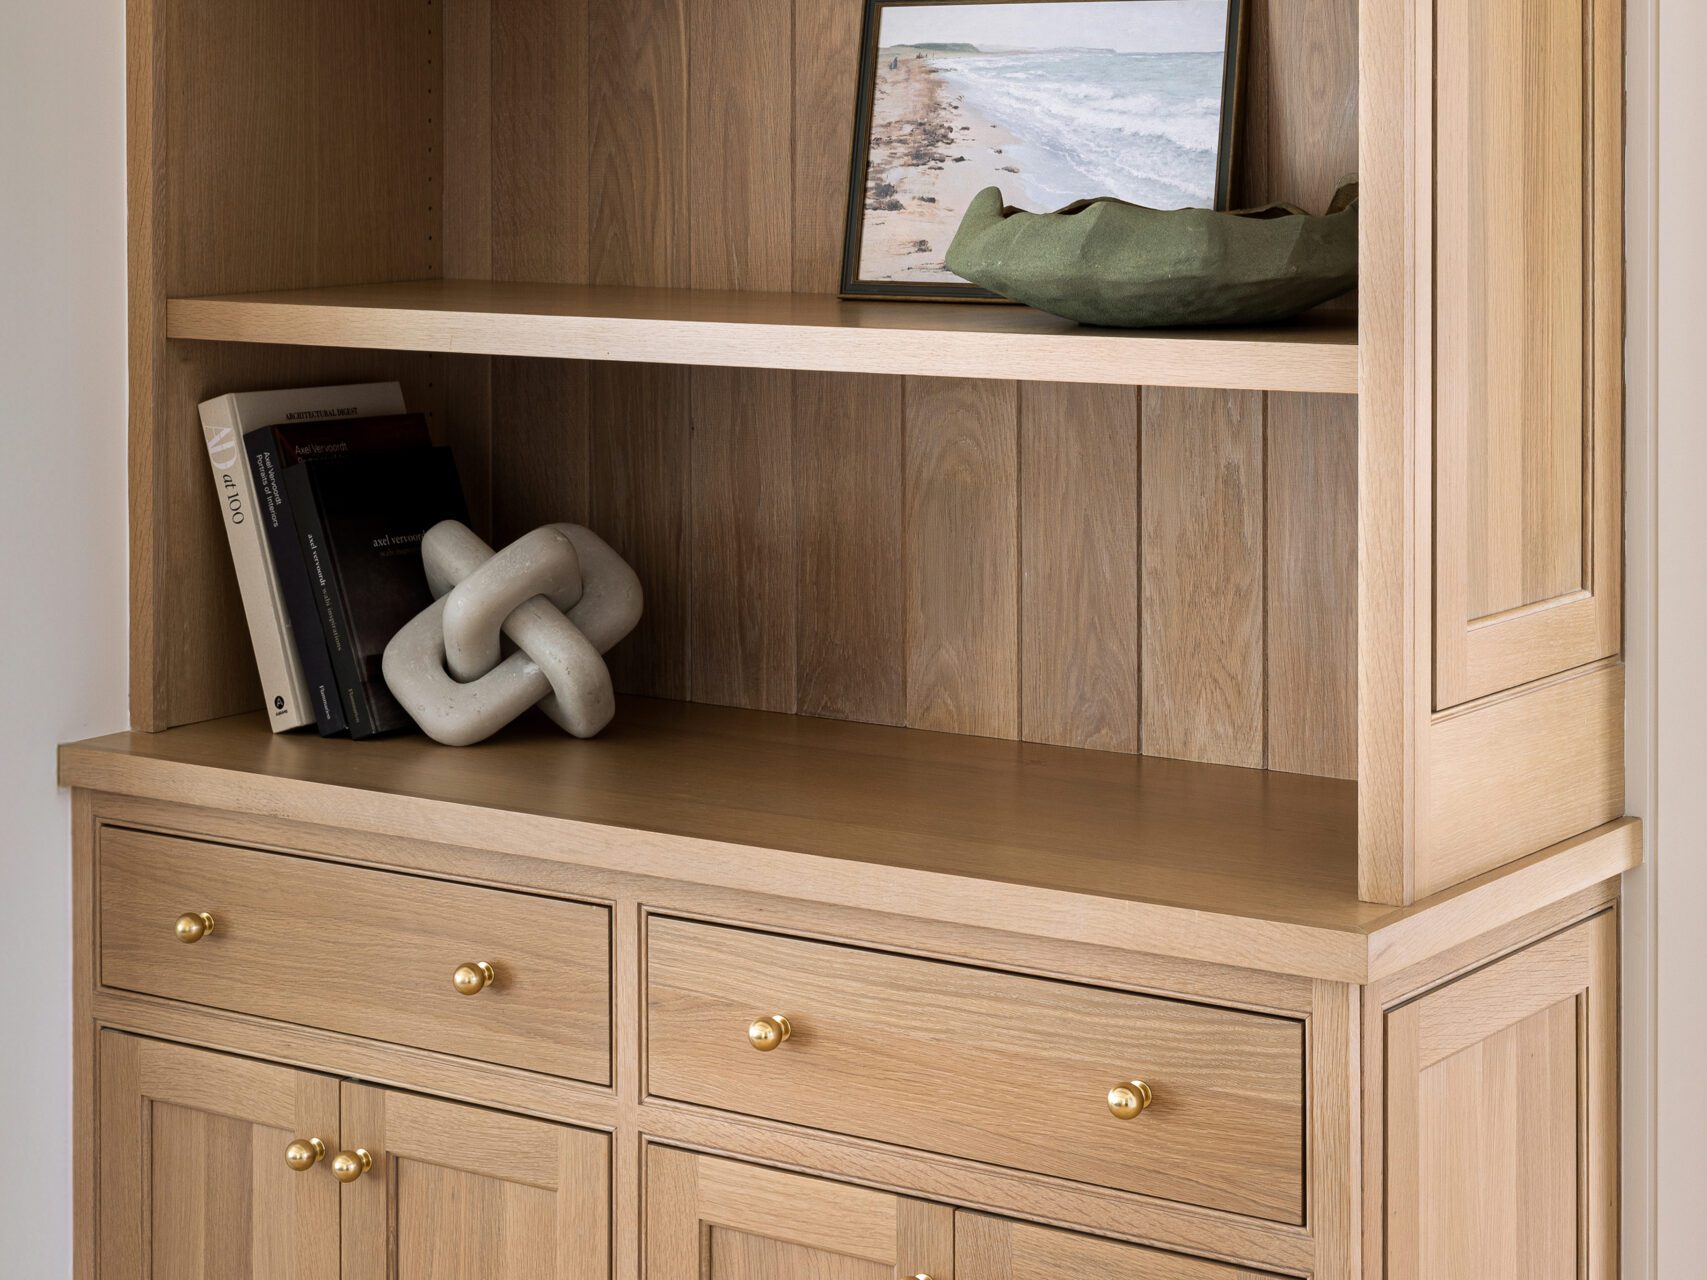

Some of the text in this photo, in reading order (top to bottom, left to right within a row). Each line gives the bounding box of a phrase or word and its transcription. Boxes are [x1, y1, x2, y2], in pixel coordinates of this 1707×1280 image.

[295, 444, 311, 455] Axel
[203, 425, 245, 525] AD at 100
[256, 454, 279, 528] Portraits of Interiors
[263, 451, 282, 506] Axel Vervoordt
[307, 533, 318, 550] axel
[373, 534, 391, 548] axel
[312, 550, 327, 586] vervoordt
